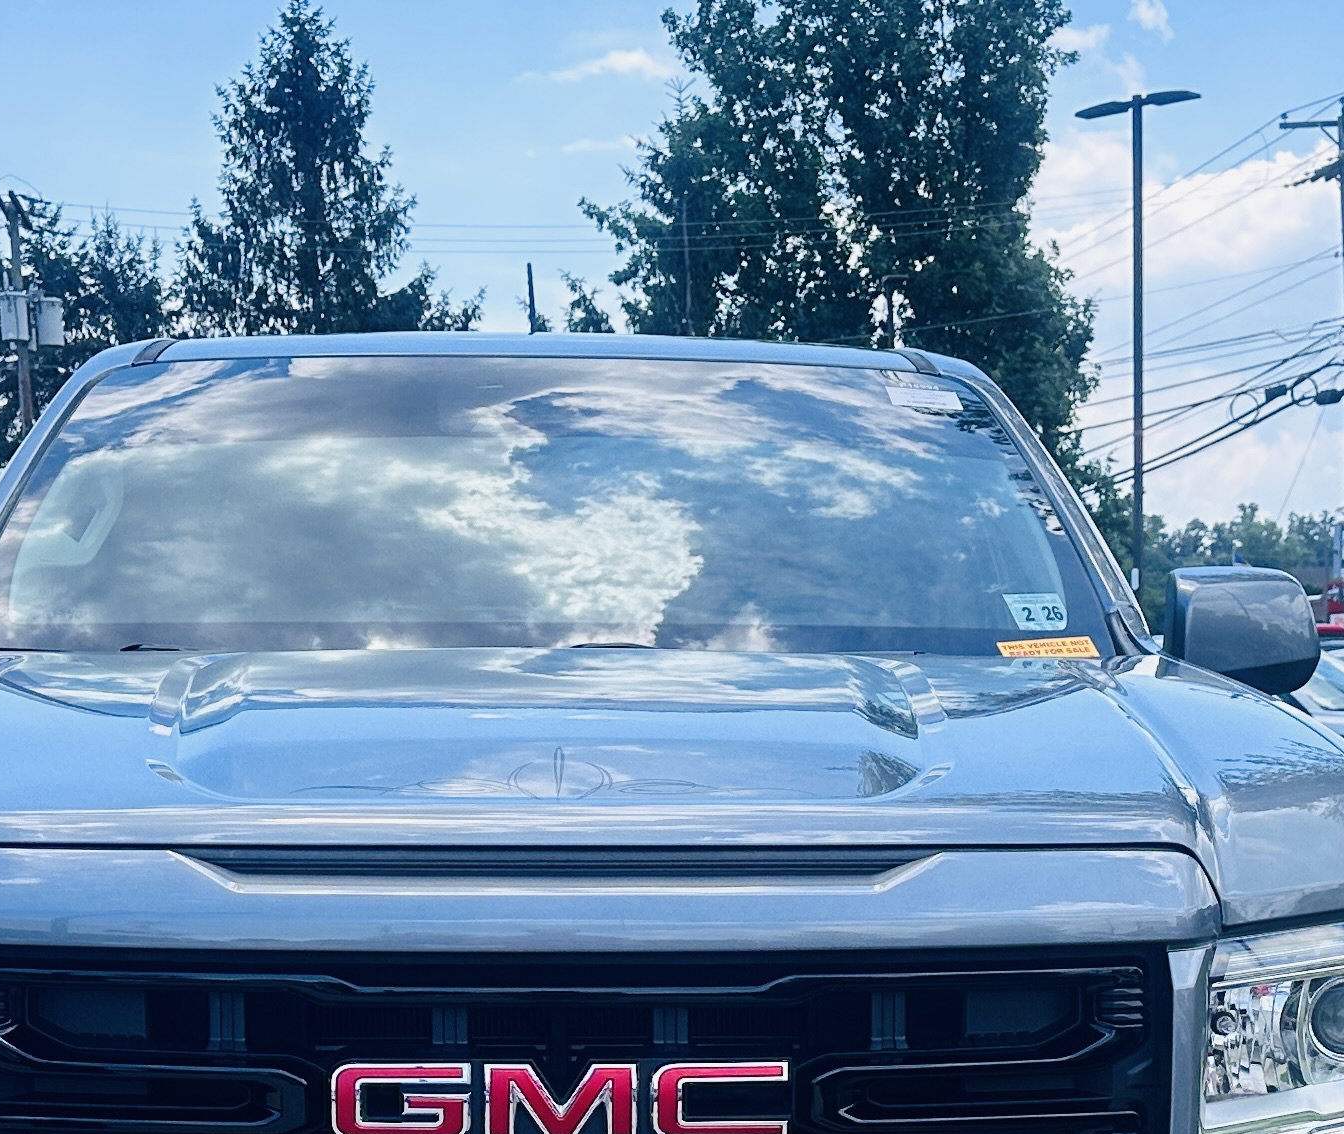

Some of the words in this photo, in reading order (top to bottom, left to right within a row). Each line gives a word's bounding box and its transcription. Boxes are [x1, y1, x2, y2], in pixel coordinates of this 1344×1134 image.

[1021, 606, 1036, 622] 2
[1041, 605, 1064, 621] 26
[1001, 643, 1026, 651] THIS
[1026, 640, 1068, 649] VEHICLE
[1069, 639, 1090, 647] NOT
[1044, 647, 1064, 655] FOR
[1066, 646, 1092, 654] SALE
